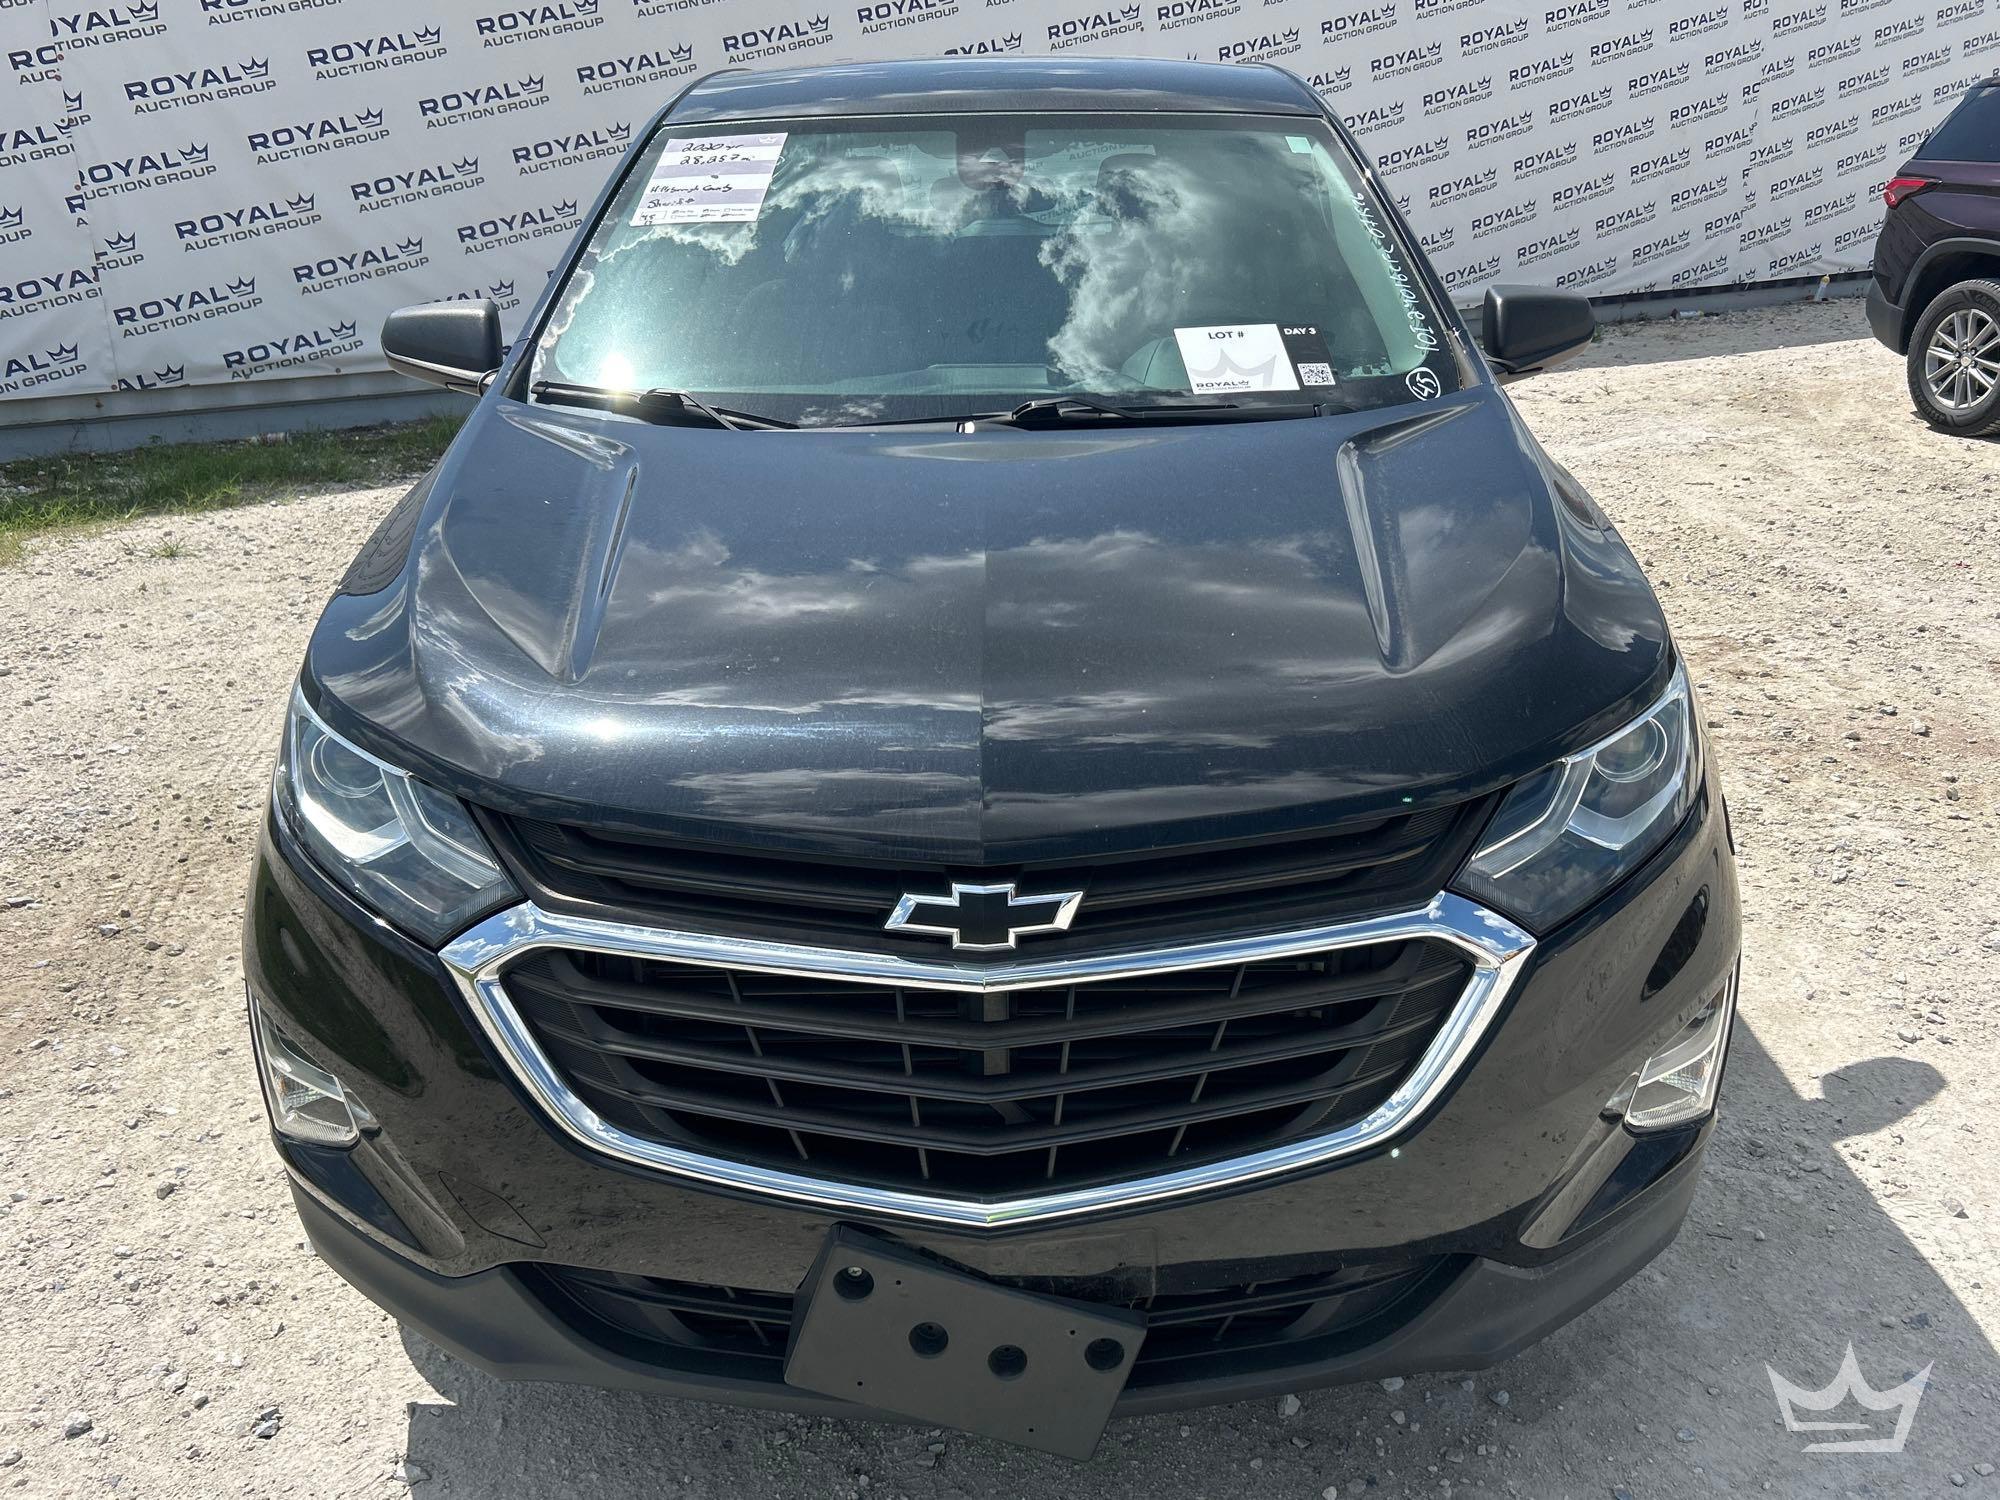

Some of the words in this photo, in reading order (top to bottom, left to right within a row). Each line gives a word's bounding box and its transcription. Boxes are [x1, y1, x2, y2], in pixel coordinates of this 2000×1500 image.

[208, 4, 286, 26] AUCTION
[476, 4, 575, 34] ROYAL
[861, 16, 916, 34] AUCTION
[917, 7, 960, 23] GROUP
[1159, 14, 1204, 31] AUCTION
[1206, 6, 1241, 20] GROUP
[1321, 9, 1380, 33] ROYAL
[1416, 5, 1454, 20] AUCTION
[1545, 1, 1595, 23] ROYAL
[1546, 18, 1581, 32] AUCTION
[1582, 11, 1609, 23] GROUP
[103, 23, 167, 43] GROUP
[483, 27, 550, 48] AUCTION
[552, 17, 604, 35] GROUP
[722, 22, 808, 52] ROYAL
[1046, 12, 1118, 39] ROYAL
[1049, 32, 1099, 51] AUCTION
[1100, 22, 1138, 38] GROUP
[1323, 28, 1364, 43] AUCTION
[1365, 20, 1397, 34] GROUP
[1460, 23, 1514, 47] ROYAL
[1874, 19, 1913, 39] ROYAL
[1874, 34, 1902, 48] AUCTION
[1903, 27, 1924, 39] GROUP
[307, 34, 416, 67] ROYAL
[727, 44, 786, 64] AUCTION
[788, 34, 833, 51] GROUP
[1219, 34, 1282, 59] ROYAL
[1266, 45, 1300, 59] GROUP
[1461, 41, 1499, 57] AUCTION
[1500, 32, 1528, 46] GROUP
[1590, 34, 1639, 57] ROYAL
[1590, 51, 1625, 67] AUCTION
[1626, 42, 1653, 56] GROUP
[315, 58, 389, 81] AUCTION
[391, 47, 447, 66] GROUP
[577, 51, 670, 83] ROYAL
[1371, 47, 1427, 72] ROYAL
[1372, 65, 1411, 82] AUCTION
[1412, 57, 1442, 71] GROUP
[1509, 58, 1559, 81] ROYAL
[124, 66, 242, 100] ROYAL
[583, 74, 646, 95] AUCTION
[648, 63, 697, 81] GROUP
[1510, 75, 1545, 91] AUCTION
[1546, 66, 1573, 80] GROUP
[1628, 67, 1676, 91] ROYAL
[1629, 84, 1662, 100] AUCTION
[1663, 75, 1689, 89] GROUP
[1838, 70, 1879, 91] ROYAL
[1838, 85, 1866, 99] AUCTION
[1867, 77, 1889, 89] GROUP
[134, 92, 214, 115] AUCTION
[215, 79, 277, 99] GROUP
[419, 83, 520, 116] ROYAL
[1422, 82, 1477, 107] ROYAL
[1424, 100, 1461, 116] AUCTION
[1463, 91, 1492, 105] GROUP
[1549, 91, 1598, 115] ROYAL
[426, 107, 495, 129] AUCTION
[496, 95, 550, 114] GROUP
[1344, 106, 1389, 129] OYAL
[1549, 108, 1584, 125] AUCTION
[1585, 99, 1612, 113] GROUP
[1670, 98, 1716, 121] ROYAL
[1670, 114, 1702, 130] AUCTION
[1703, 105, 1728, 119] GROUP
[247, 116, 358, 151] ROYAL
[1374, 117, 1405, 131] GROUP
[1467, 116, 1519, 141] ROYAL
[256, 142, 331, 165] AUCTION
[332, 129, 390, 149] GROUP
[512, 131, 608, 163] ROYAL
[1468, 134, 1504, 150] AUCTION
[1505, 124, 1533, 139] GROUP
[519, 154, 584, 175] AUCTION
[1378, 143, 1434, 168] ROYAL
[1380, 160, 1418, 177] AUCTION
[1419, 150, 1449, 165] GROUP
[84, 179, 151, 201] UCTION
[155, 164, 217, 186] GROUP
[350, 165, 455, 200] ROYAL
[358, 189, 429, 213] AUCTION
[430, 176, 485, 196] GROUP
[1429, 174, 1482, 199] ROYAL
[1430, 191, 1467, 209] AUCTION
[1468, 181, 1497, 196] GROUP
[1770, 171, 1811, 194] ROYAL
[1770, 187, 1799, 202] AUCTION
[1800, 178, 1822, 191] GROUP
[175, 202, 289, 239] ROYAL
[457, 208, 555, 242] ROYAL
[1472, 205, 1523, 231] ROYAL
[1472, 222, 1508, 240] AUCTION
[1509, 212, 1536, 227] GROUP
[184, 227, 261, 252] AUCTION
[262, 214, 322, 234] GROUP
[464, 232, 530, 254] AUCTION
[532, 219, 583, 238] GROUP
[1517, 234, 1566, 259] ROYAL
[1518, 250, 1552, 267] AUCTION
[1553, 240, 1579, 255] GROUP
[293, 246, 399, 282] ROYAL
[301, 270, 373, 295] AUCTION
[374, 256, 429, 277] GROUP
[1440, 262, 1487, 284] OYAL
[1472, 269, 1501, 284] GROUP
[1556, 262, 1604, 287] ROYAL
[0, 292, 82, 320] AUCTION
[113, 287, 229, 325] ROYAL
[123, 312, 201, 339] AUCTION
[203, 297, 263, 319] GROUP
[1208, 331, 1233, 340] LOT
[1308, 327, 1317, 335] 3
[223, 330, 332, 368] ROYAL
[232, 355, 305, 381] AUCTION
[307, 340, 363, 361] GROUP
[22, 364, 87, 388] GROUP
